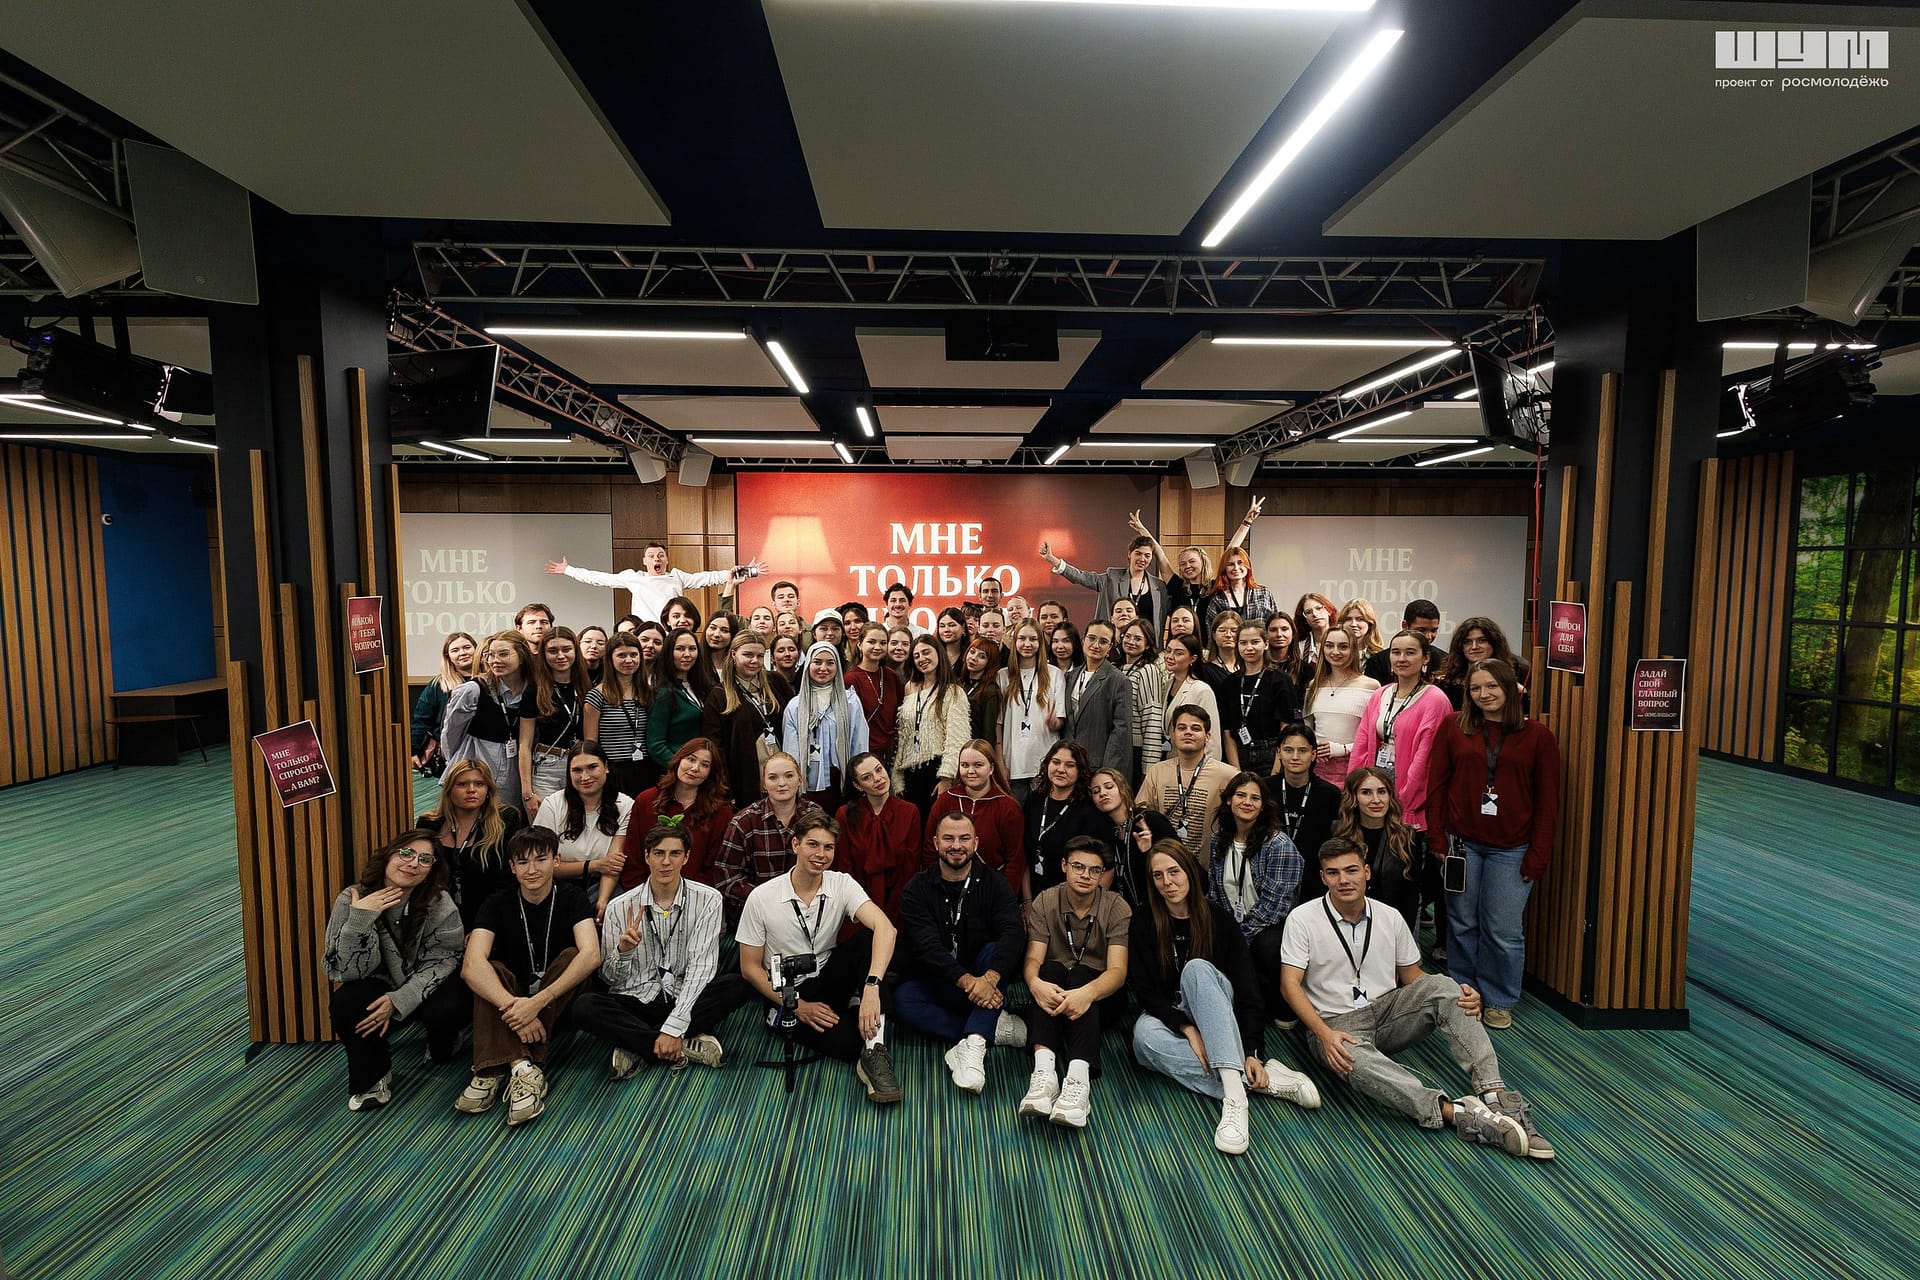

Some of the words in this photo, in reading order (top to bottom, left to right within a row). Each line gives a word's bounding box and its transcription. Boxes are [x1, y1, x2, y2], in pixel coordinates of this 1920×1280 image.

[889, 522, 983, 555] МНЕ
[419, 549, 489, 573] МНЕ
[1348, 548, 1414, 572] МНЕ
[849, 564, 1022, 598] ТОЛЬКО
[1319, 579, 1439, 603] ТОЛЬКО
[1555, 621, 1581, 631] СПРОСИ
[1560, 632, 1574, 642] ДЛЯ
[1557, 644, 1574, 654] СЕБЯ
[1639, 669, 1667, 678] ЗАДАЙ
[1638, 679, 1660, 688] СВОЙ
[1638, 690, 1677, 698] ГЛАВНЫЙ
[1638, 700, 1669, 708] ВОПРОС
[271, 749, 291, 760] МНЕ
[274, 755, 309, 770] ТОЛЬКО
[279, 762, 323, 780] СПРОСИТЬ
[298, 776, 320, 788] ВАМ?
